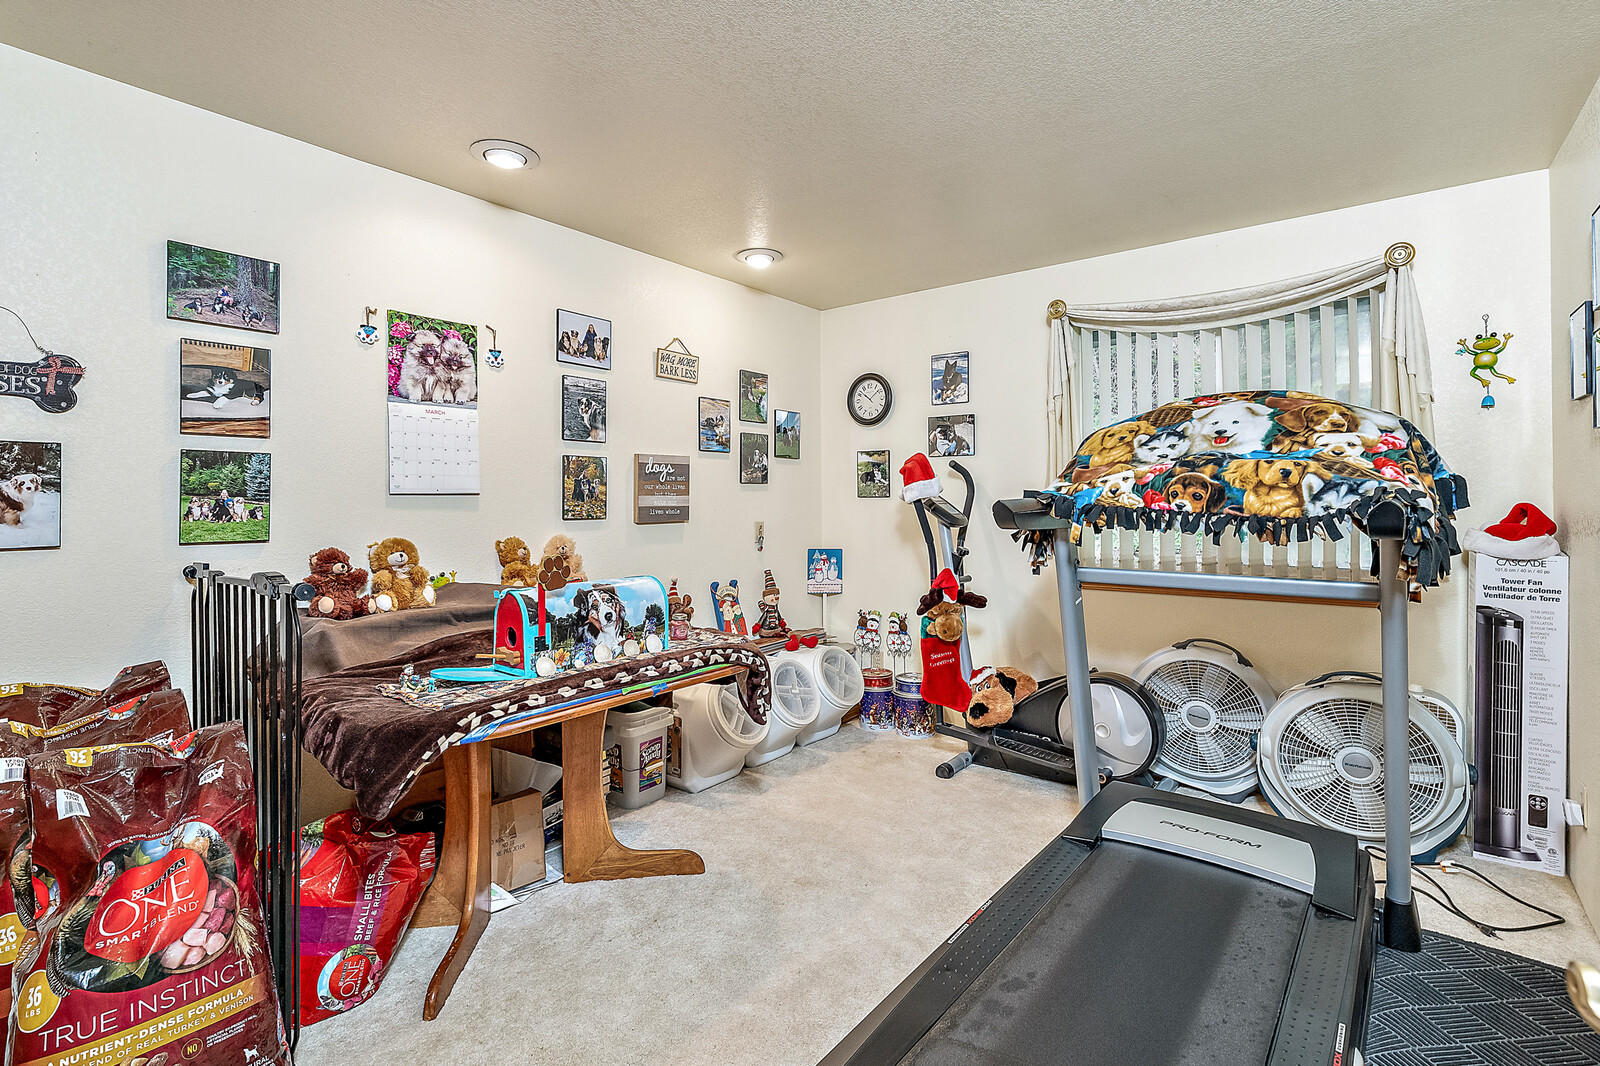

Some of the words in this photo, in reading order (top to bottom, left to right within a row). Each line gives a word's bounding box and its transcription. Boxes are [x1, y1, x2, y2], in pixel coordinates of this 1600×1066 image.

[15, 365, 38, 375] DOG
[660, 352, 676, 365] WAG
[677, 357, 697, 368] MORE
[660, 364, 679, 376] BARK
[681, 368, 697, 380] LESS
[645, 457, 675, 482] dogs
[1482, 585, 1526, 593] Ventilateur
[1483, 592, 1525, 600] Ventilador
[69, 750, 88, 764] 36
[641, 744, 660, 759] Scoop
[1160, 820, 1262, 849] PRO-FORM
[145, 858, 186, 894] PURINA
[99, 866, 195, 936] ONE
[354, 902, 371, 941] SMALL
[363, 873, 376, 900] BITES
[364, 917, 375, 941] BEEF
[373, 888, 382, 908] RICE
[0, 925, 17, 946] 36
[0, 943, 16, 954] LBS
[341, 960, 361, 997] ONE
[26, 985, 42, 1009] 36
[38, 1008, 118, 1052] TRUE
[130, 958, 246, 1022] INSTINCT
[25, 1008, 41, 1018] LBS
[60, 1013, 184, 1066] NUTRIENT-DENSE
[188, 988, 244, 1019] FORMULA
[116, 1047, 132, 1058] OF
[136, 1035, 165, 1051] REAL
[167, 1015, 207, 1037] TURKEY
[210, 1012, 216, 1020] &
[219, 994, 254, 1015] VENISON
[186, 1043, 198, 1055] NO
